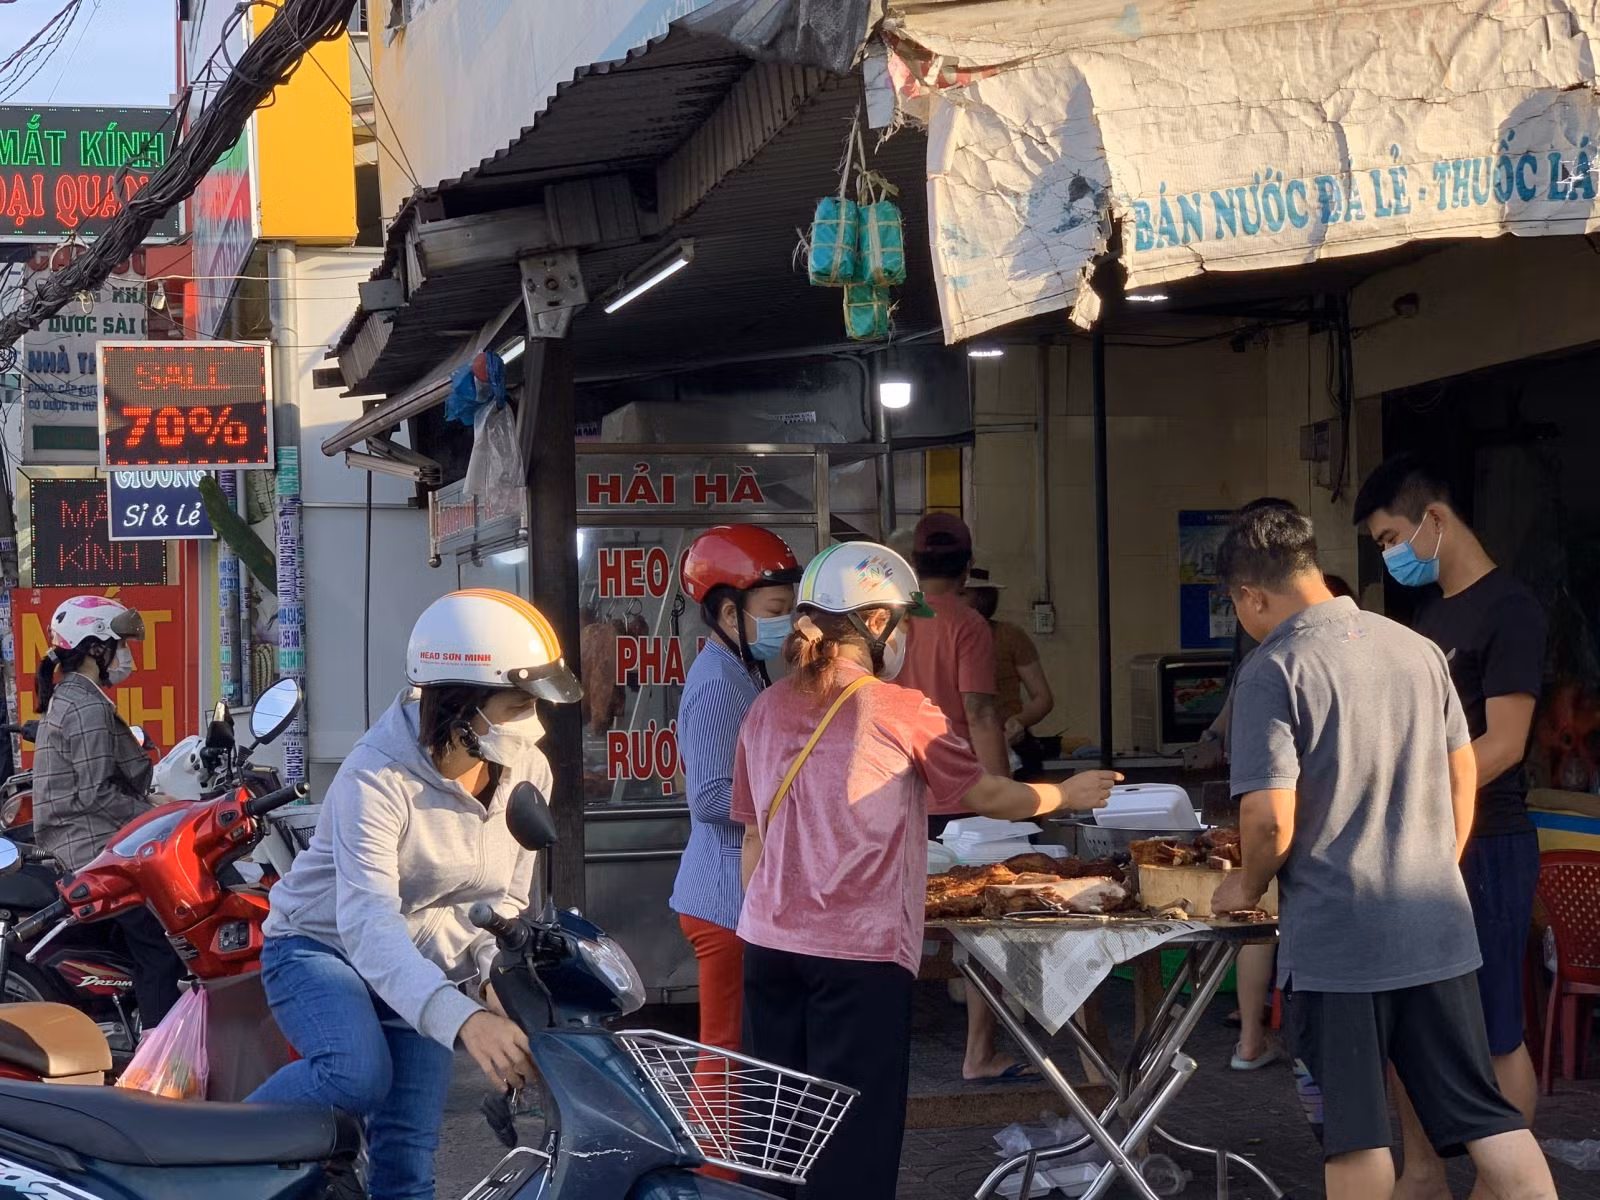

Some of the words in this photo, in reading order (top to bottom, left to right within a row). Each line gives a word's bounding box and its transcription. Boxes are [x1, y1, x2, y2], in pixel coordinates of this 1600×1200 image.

[0, 114, 67, 166] MẮT
[80, 121, 165, 168] KÍNH
[0, 174, 45, 226] ẠI
[1133, 181, 1204, 252] BÁN
[1210, 167, 1309, 240] NƯỚC
[1433, 128, 1537, 210] THUỐC
[1547, 134, 1597, 202] LÁ
[103, 312, 136, 335] SÀI
[123, 406, 249, 445] 70%
[586, 462, 676, 505] HẢI
[693, 465, 766, 505] HÀ
[60, 534, 139, 571] KÍNH
[598, 546, 670, 599] HEO
[607, 718, 687, 797] RƯỢ
[77, 975, 133, 988] DREAM
